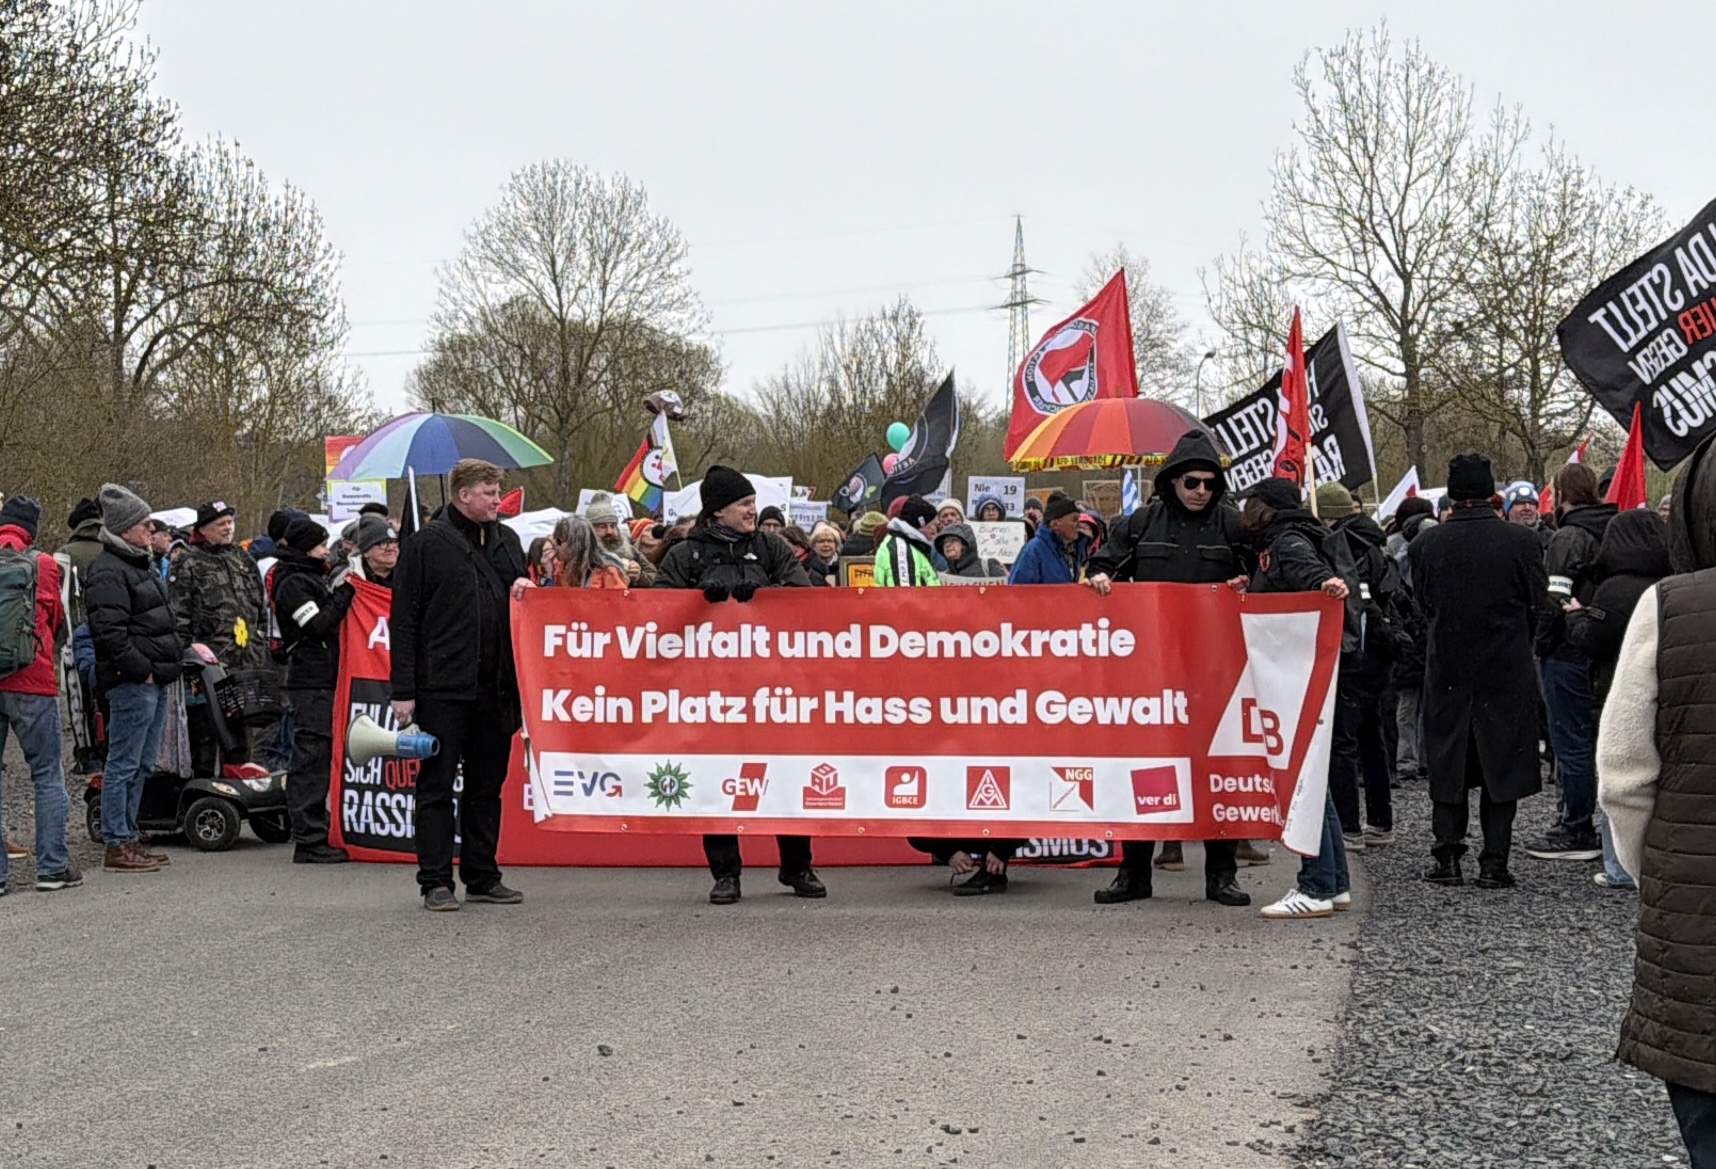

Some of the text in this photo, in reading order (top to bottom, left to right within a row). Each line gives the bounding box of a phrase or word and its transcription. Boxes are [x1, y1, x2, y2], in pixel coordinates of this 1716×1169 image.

[974, 483, 1018, 496] Nie 19
[543, 617, 1136, 659] Für Vielfalt und Demokratie
[541, 685, 1189, 726] Kein Platz für Hass und Gewalt
[553, 770, 623, 797] EVG
[1065, 769, 1092, 781] NGG
[1209, 774, 1275, 794] Deuts
[721, 779, 769, 796] GEW
[343, 789, 416, 839] RASSI
